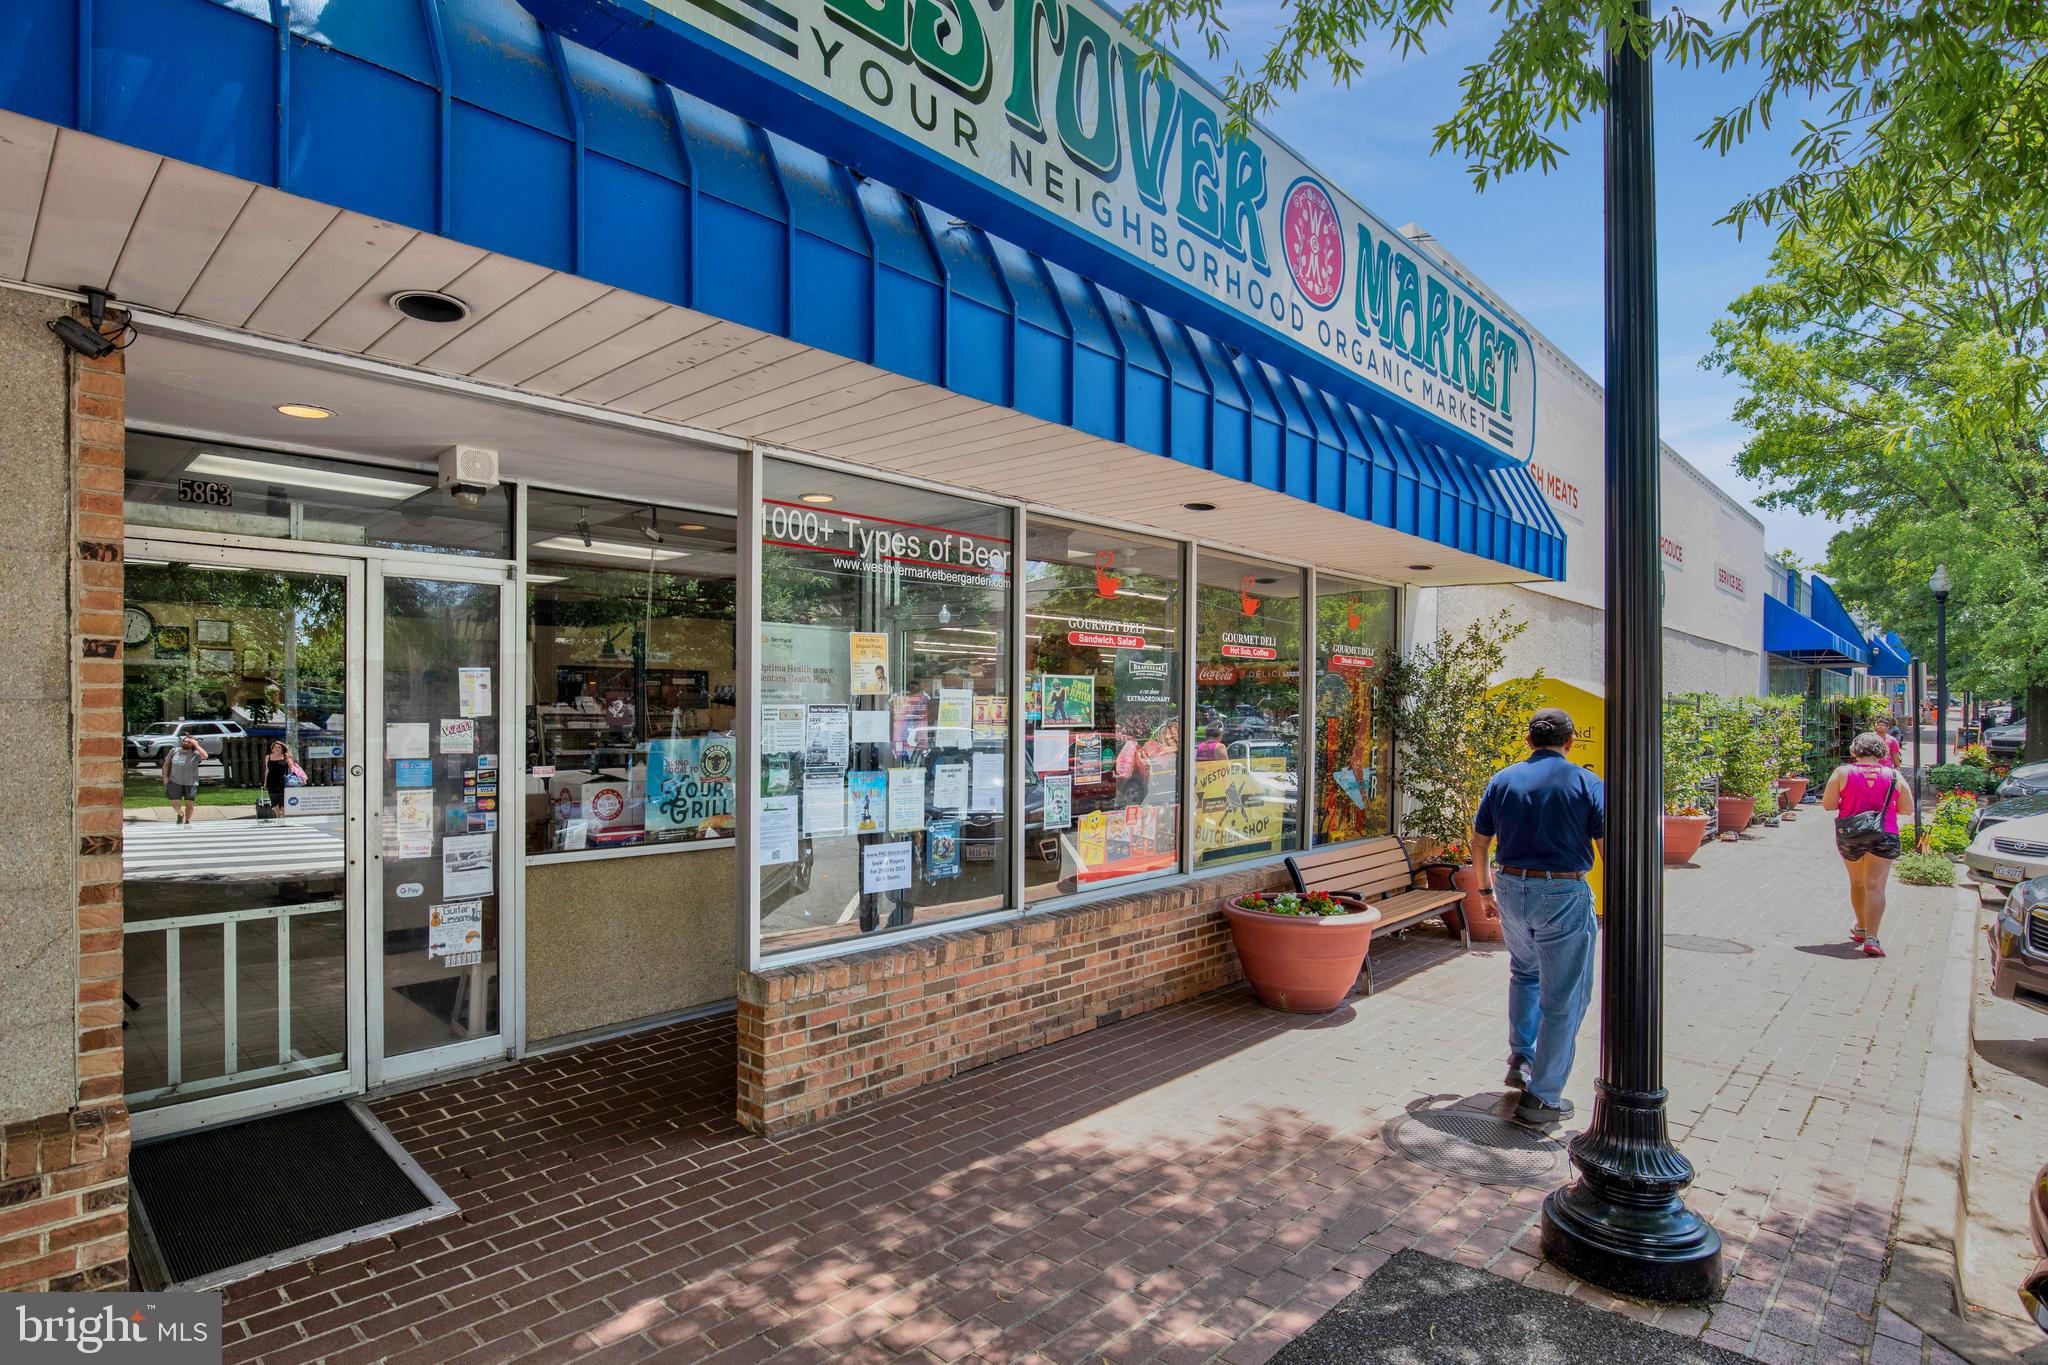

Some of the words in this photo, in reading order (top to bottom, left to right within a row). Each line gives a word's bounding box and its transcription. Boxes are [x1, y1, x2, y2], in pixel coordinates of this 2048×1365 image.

[809, 26, 979, 158] YOUR
[1010, 140, 1305, 332] NEIGHBORHOOD
[1318, 320, 1414, 393] ORGANIC
[1423, 378, 1489, 432] MARKET
[1355, 222, 1519, 422] MARKET
[178, 479, 232, 506] 5863
[1530, 463, 1544, 491] SH
[1547, 472, 1578, 509] MEATS
[762, 505, 834, 545] 1000+
[841, 517, 921, 559] Types
[928, 534, 953, 562] of
[959, 536, 1011, 571] Beer
[833, 557, 1011, 589] www.westovermarketbeergarden.com
[1068, 617, 1120, 632] GOURMET
[1122, 622, 1146, 634] DELI
[1079, 634, 1116, 645] Sandwich,
[1117, 637, 1137, 646] Salad
[1222, 632, 1260, 645] GOURMET
[1260, 636, 1277, 646] DELI
[1241, 647, 1252, 656] Sub,
[1253, 649, 1269, 657] Coffee
[1333, 644, 1360, 655] GOURMET
[1361, 648, 1374, 656] DELI
[787, 664, 812, 673] Health
[660, 797, 732, 824] GRILL
[1243, 816, 1269, 838] SHOP
[441, 915, 472, 925] Lessons
[443, 906, 470, 915] Guitar
